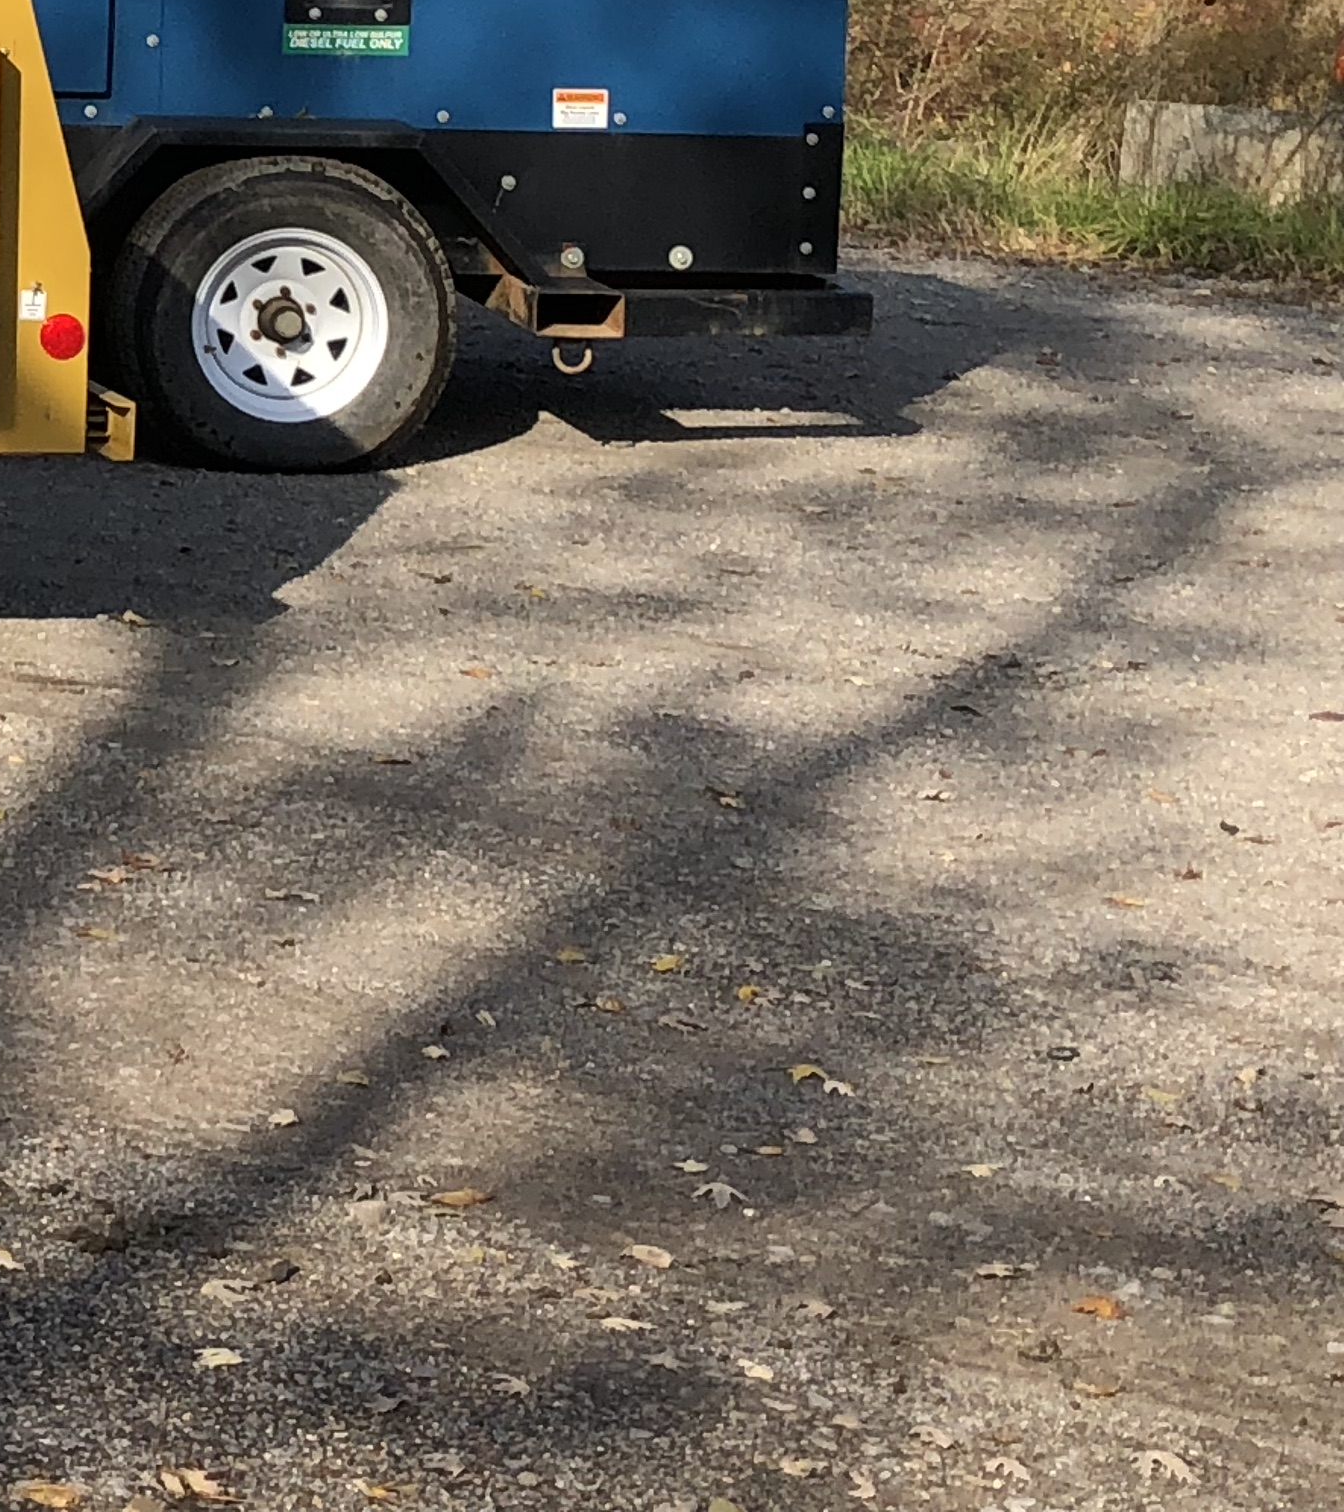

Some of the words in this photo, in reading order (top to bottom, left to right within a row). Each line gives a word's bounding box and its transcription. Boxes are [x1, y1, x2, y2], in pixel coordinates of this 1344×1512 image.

[289, 38, 333, 48] DIESEL
[334, 38, 366, 49] FUEL
[369, 38, 404, 50] ONLY
